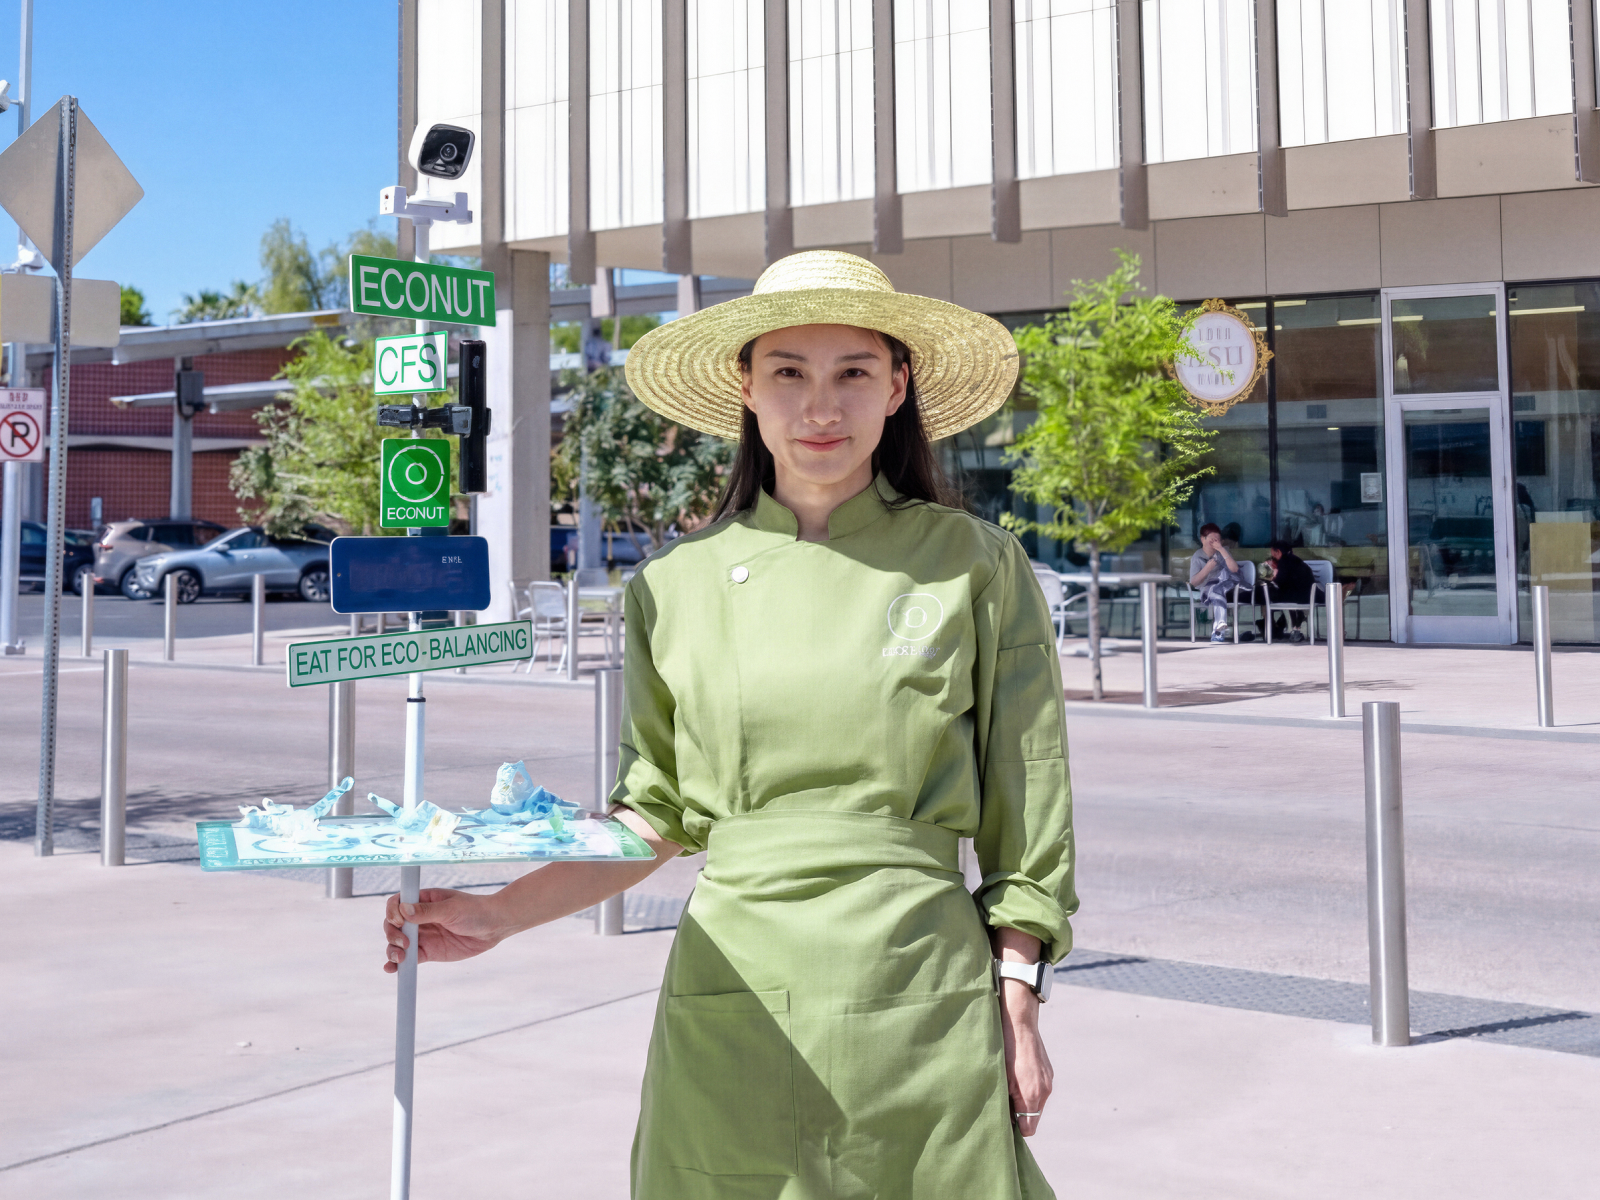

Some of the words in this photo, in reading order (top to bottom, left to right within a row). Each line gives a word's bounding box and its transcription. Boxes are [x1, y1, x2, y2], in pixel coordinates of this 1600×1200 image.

[360, 265, 490, 318] ECONUT
[379, 343, 437, 386] CFS
[387, 506, 445, 520] ECONUT
[296, 649, 332, 676] EAT
[337, 645, 377, 671] FOR
